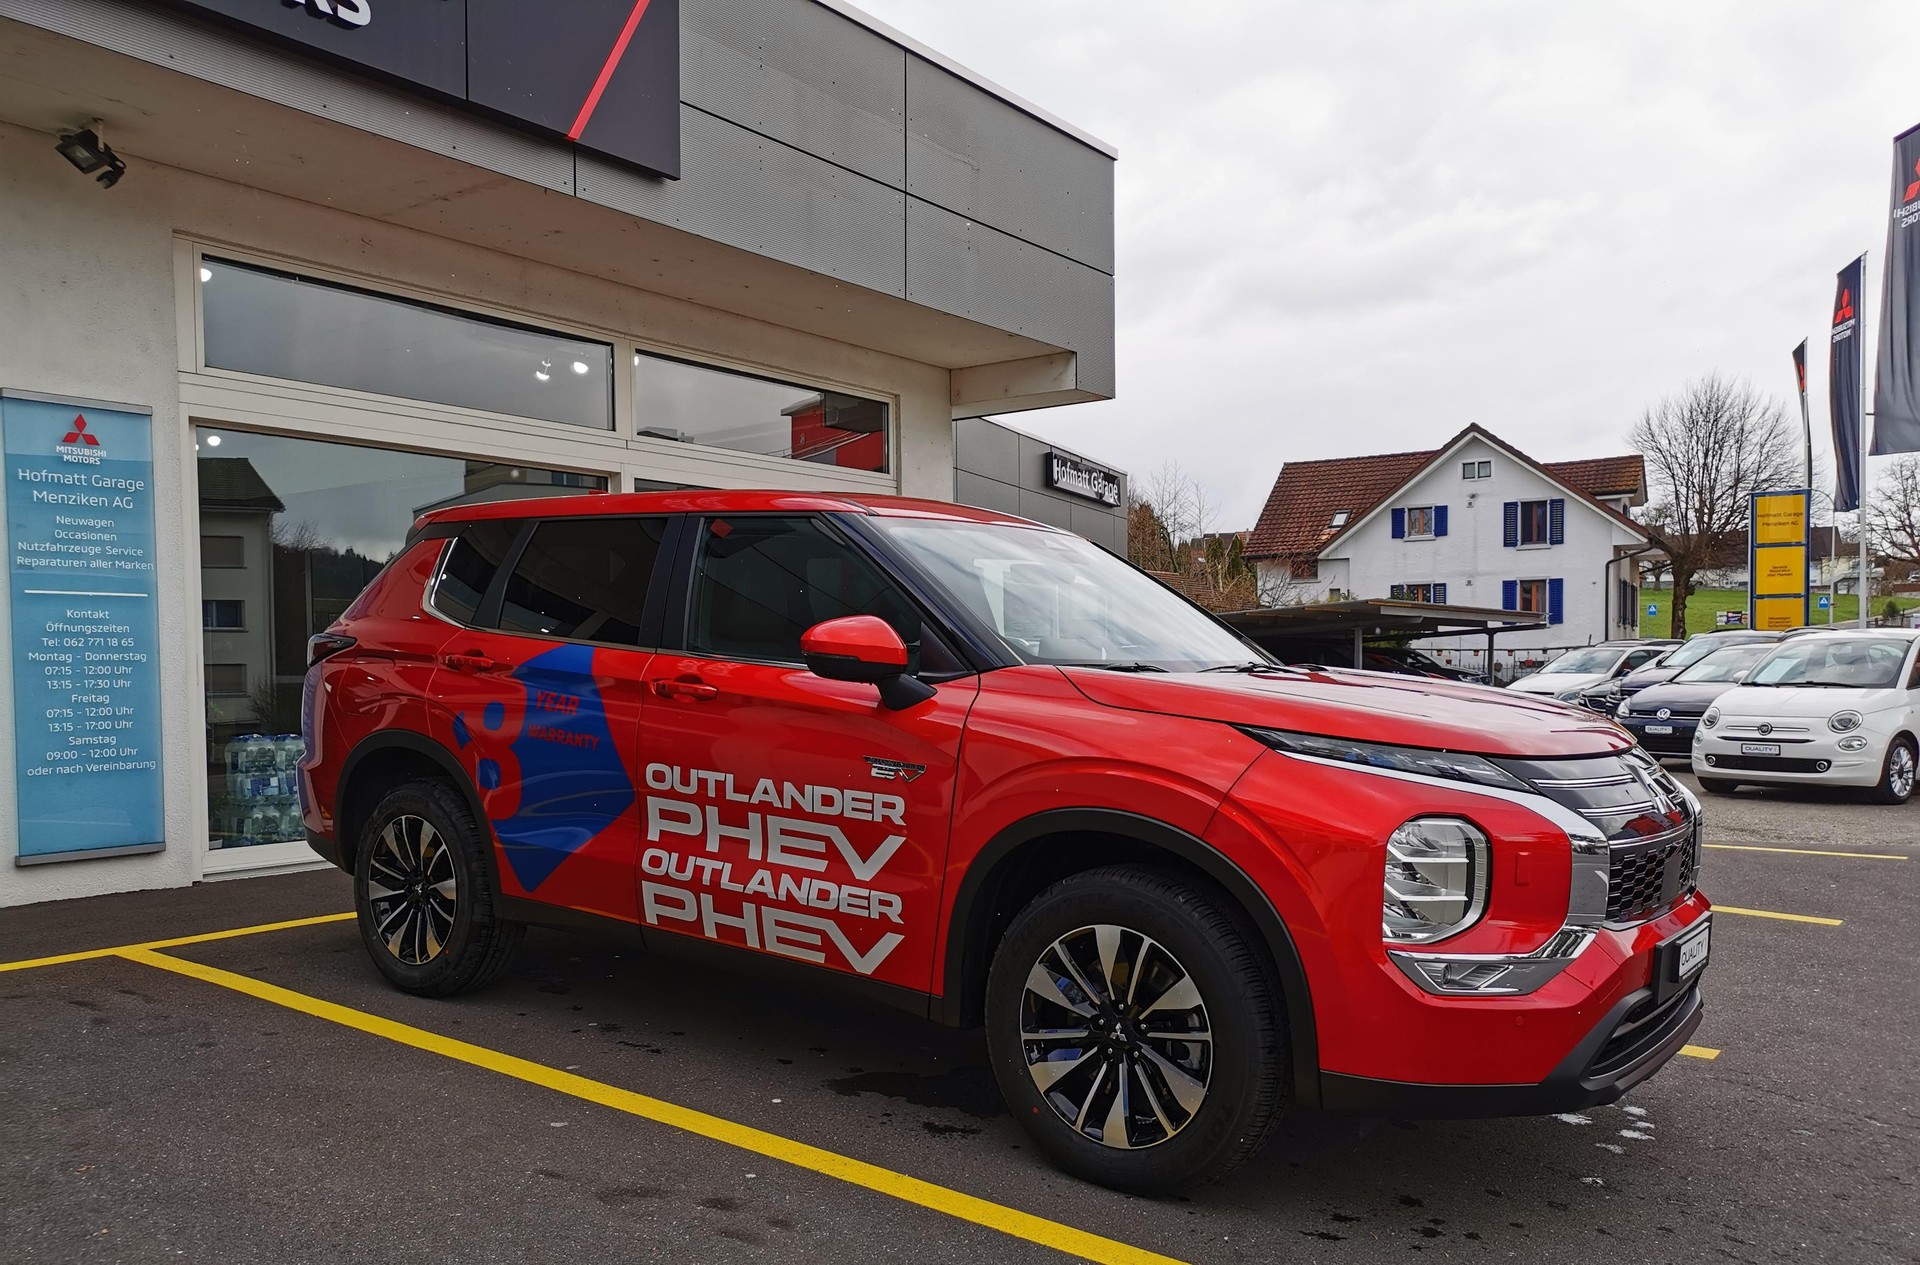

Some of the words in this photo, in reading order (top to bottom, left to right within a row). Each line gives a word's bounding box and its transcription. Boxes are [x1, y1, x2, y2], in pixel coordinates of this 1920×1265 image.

[56, 446, 107, 458] MITSUBISHI
[63, 455, 101, 465] MOTORS
[18, 468, 87, 486] Hofmatt
[92, 474, 144, 492] Garage
[1053, 458, 1089, 490] Hofmatt
[1091, 472, 1118, 501] Garage
[33, 490, 108, 507] Menziken
[112, 497, 134, 509] AG
[56, 515, 115, 528] Neuwagen
[54, 529, 117, 541] Occasionen
[18, 541, 101, 555] Nutzfahrzeuge
[105, 545, 144, 556] Service
[17, 556, 87, 569] Reparaturen
[90, 559, 113, 569] aller
[115, 560, 153, 571] Marken
[66, 609, 110, 619] Kontakt
[46, 621, 130, 634] Öffnungszeiten
[41, 637, 61, 647] Tel:
[63, 637, 84, 647] 062
[88, 637, 105, 647] 771
[107, 637, 118, 647] 18
[121, 637, 134, 647] 65
[28, 652, 72, 663] Montag
[85, 652, 147, 662] Donnerstag
[44, 665, 72, 675] 07:15
[83, 666, 111, 675] 12:00
[114, 665, 133, 675] Uhr
[46, 680, 72, 689] 13:15
[83, 679, 110, 689] 17:30
[113, 679, 131, 688] Uhr
[71, 694, 110, 705] Freitag
[534, 690, 580, 716] YEAR
[46, 708, 73, 718] 07:15
[85, 707, 112, 716] 12:00
[115, 706, 134, 716] Uhr
[48, 722, 73, 732] 13:15
[85, 721, 112, 730] 17:00
[115, 720, 133, 729] Uhr
[68, 735, 117, 746] Samstag
[528, 722, 599, 750] WARRANTY
[46, 751, 78, 761] 09:00
[89, 748, 117, 758] 12:00
[119, 747, 138, 757] Uhr
[27, 766, 52, 776] oder
[56, 764, 83, 774] nach
[86, 760, 156, 772] Vereinbarung
[646, 763, 906, 826] OUTLANDER
[647, 796, 907, 881] PHEV
[641, 848, 904, 924] OUTLANDER
[641, 881, 905, 975] PHEV
